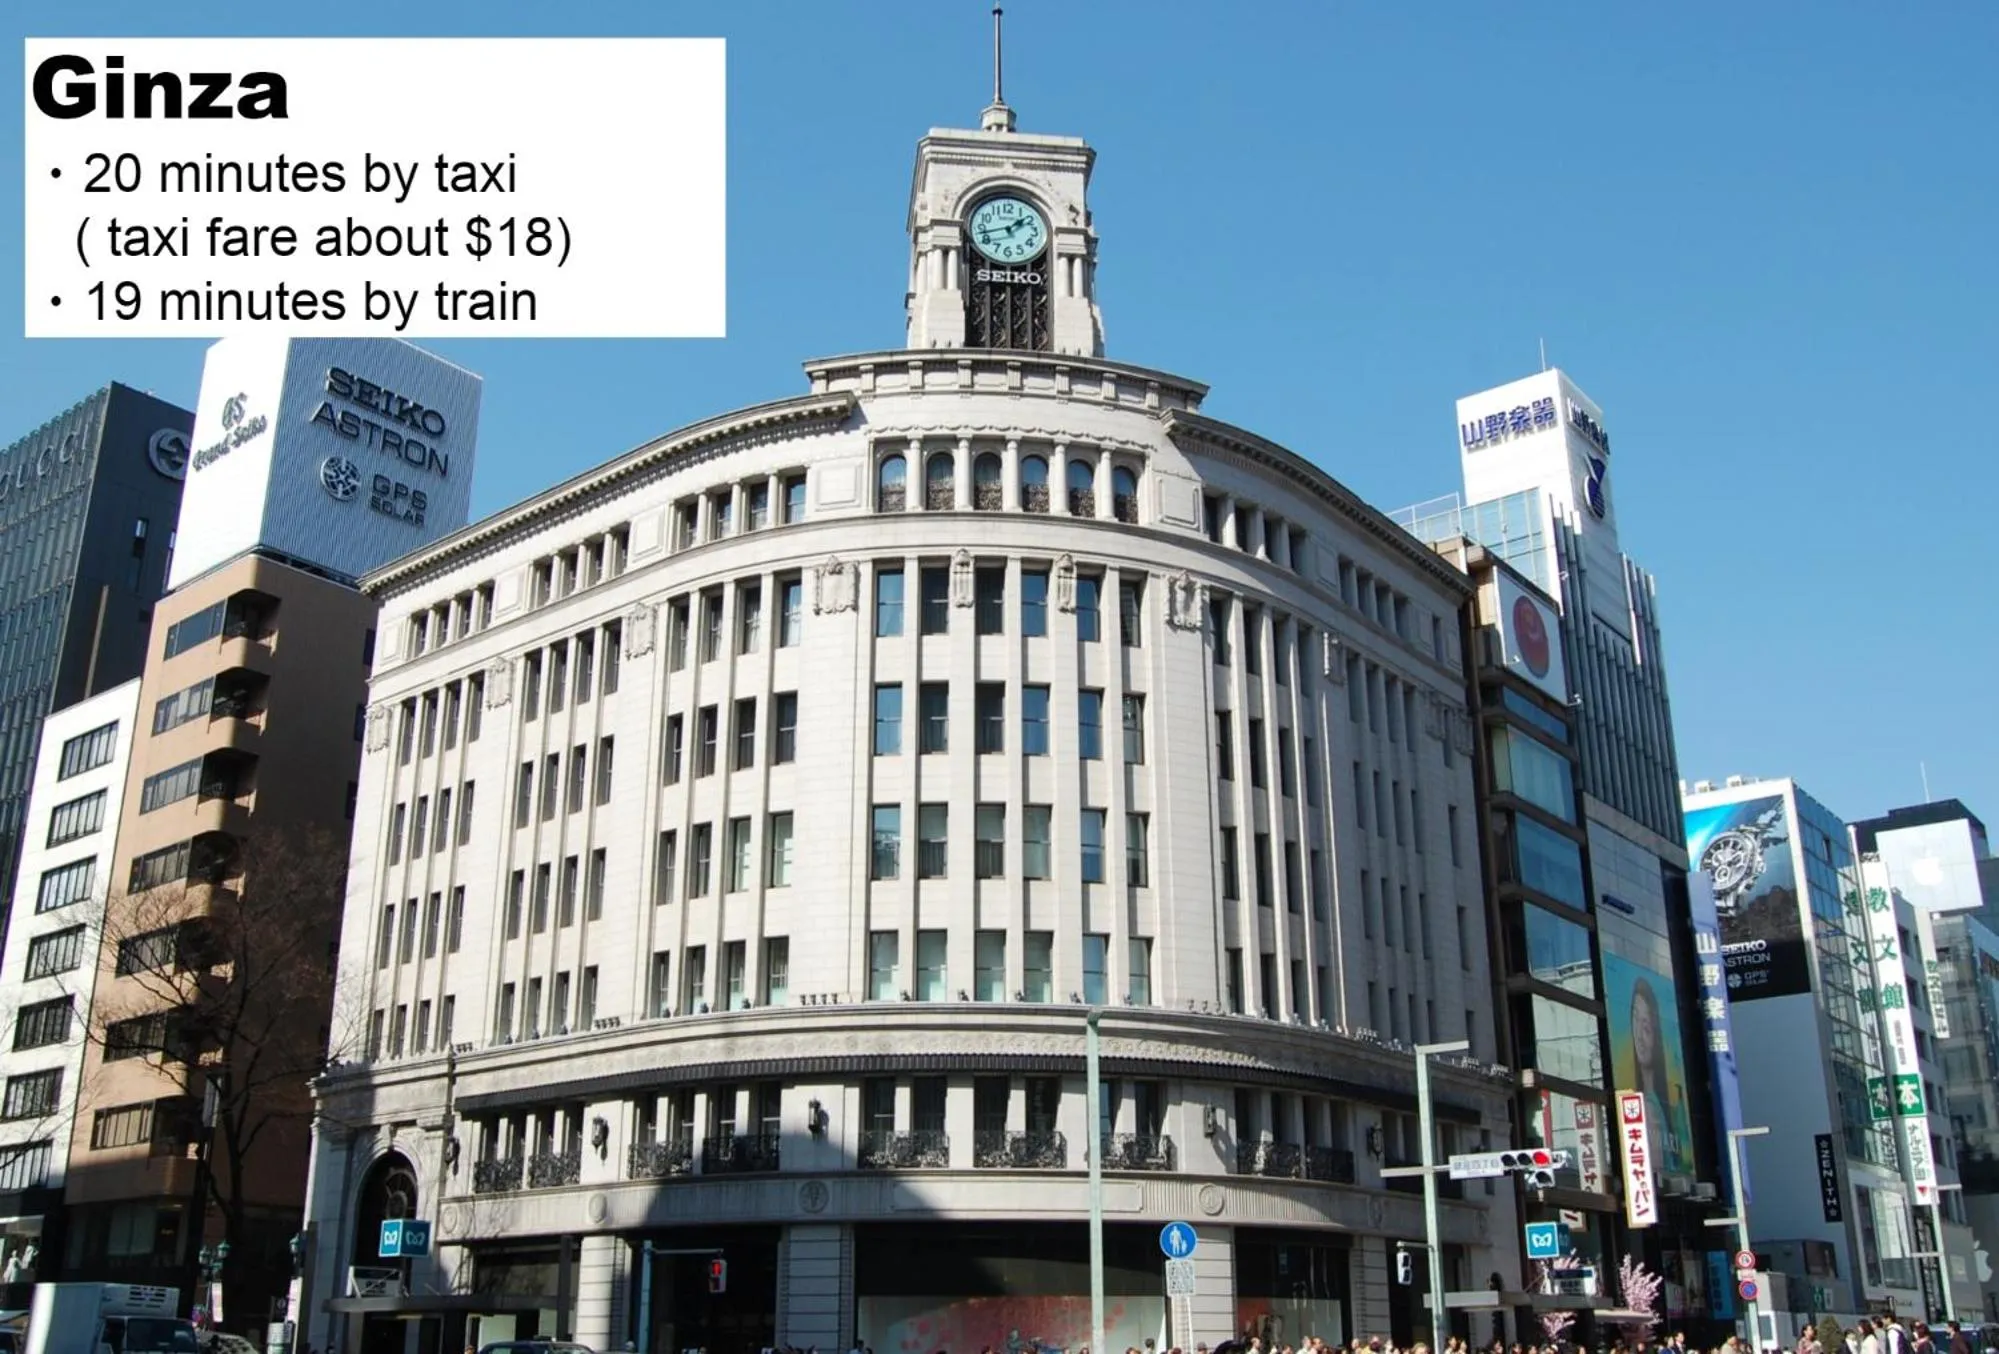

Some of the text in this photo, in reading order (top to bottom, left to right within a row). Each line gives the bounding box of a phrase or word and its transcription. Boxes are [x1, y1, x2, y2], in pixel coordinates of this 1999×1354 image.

[977, 268, 1041, 285] SEIKO
[326, 366, 446, 437] SEIKO
[1461, 397, 1555, 447] 山野楽器
[310, 400, 448, 477] ASTRON
[371, 495, 425, 526] SOLAR
[373, 474, 427, 510] GPS
[1720, 939, 1767, 955] SEIKO
[1866, 886, 1904, 1010] 教文館
[1696, 932, 1729, 1052] 山野楽器
[1896, 1080, 1920, 1109] 本
[1627, 1128, 1651, 1217] キムラヤのパン
[1820, 1148, 1838, 1207] ZENITH
